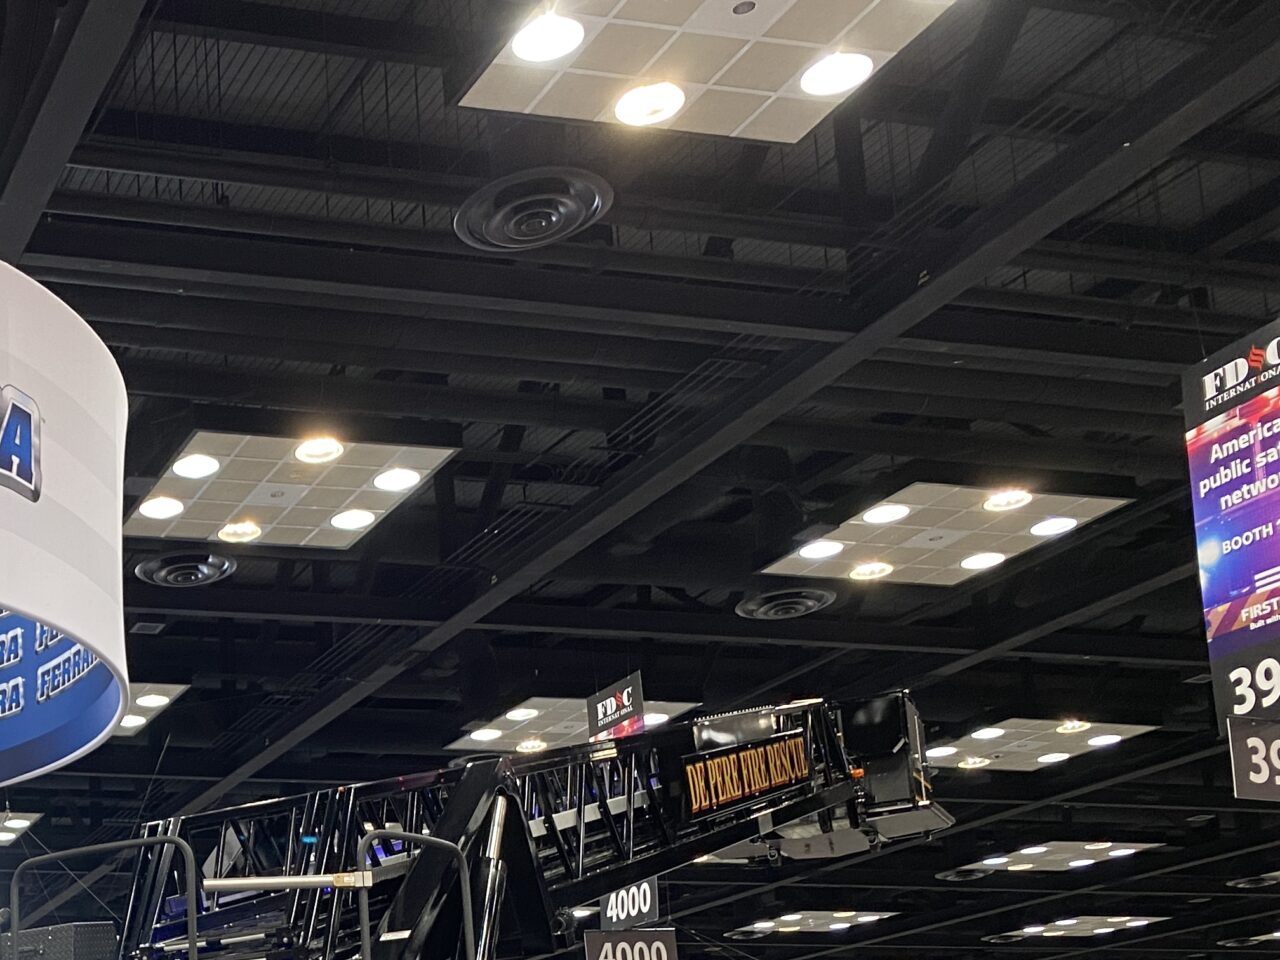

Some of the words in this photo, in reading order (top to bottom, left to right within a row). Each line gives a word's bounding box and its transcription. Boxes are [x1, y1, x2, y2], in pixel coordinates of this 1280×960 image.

[1200, 458, 1252, 498] public
[1256, 441, 1280, 468] sa
[1221, 473, 1280, 510] netwo
[1222, 523, 1273, 555] BOOTH
[37, 643, 100, 702] FERRA
[1229, 658, 1280, 714] 39
[686, 763, 709, 814] DE
[707, 754, 742, 805] PERE
[739, 746, 770, 796] FIRE
[766, 737, 808, 787] RESCUE
[606, 882, 651, 923] 4000
